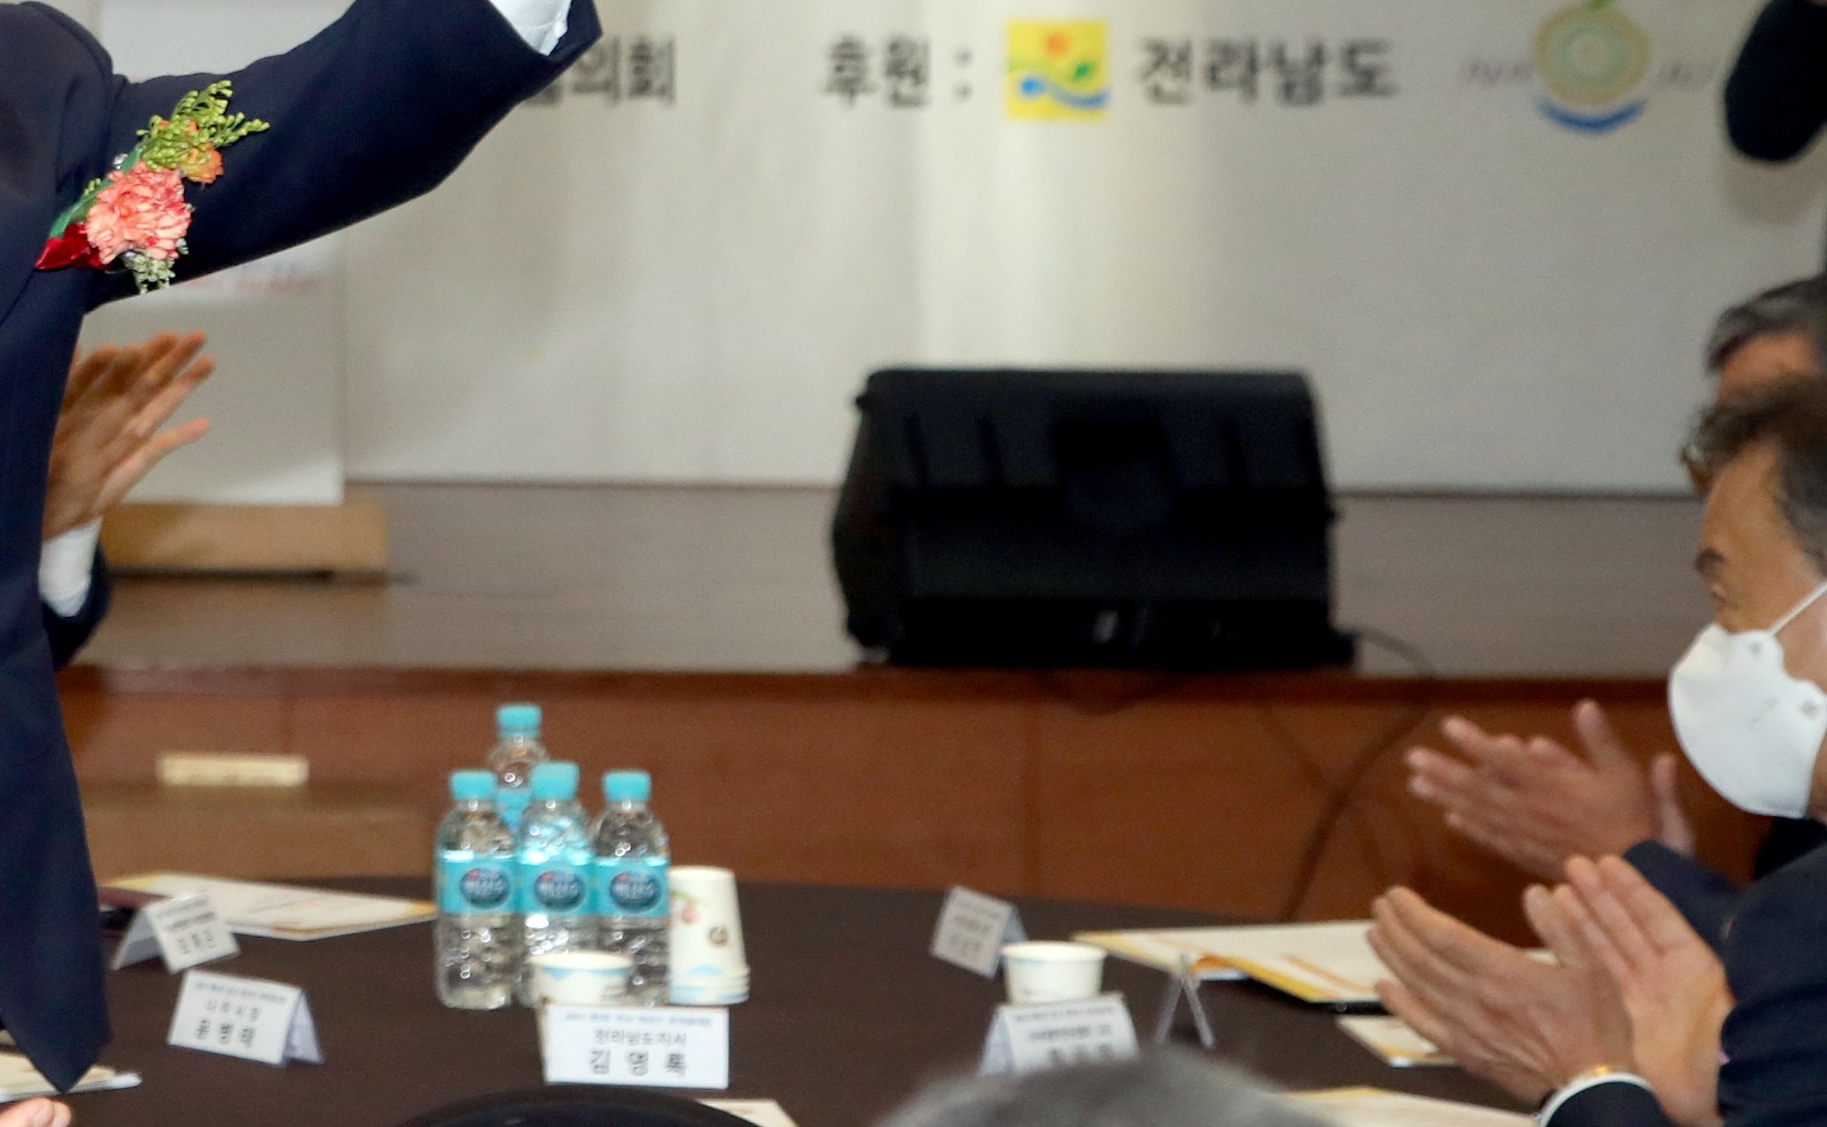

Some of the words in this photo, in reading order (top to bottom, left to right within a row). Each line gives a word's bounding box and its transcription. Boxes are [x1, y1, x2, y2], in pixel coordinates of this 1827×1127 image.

[527, 37, 674, 105] 의회
[824, 35, 928, 108] 후원
[1142, 37, 1396, 106] 전라남도
